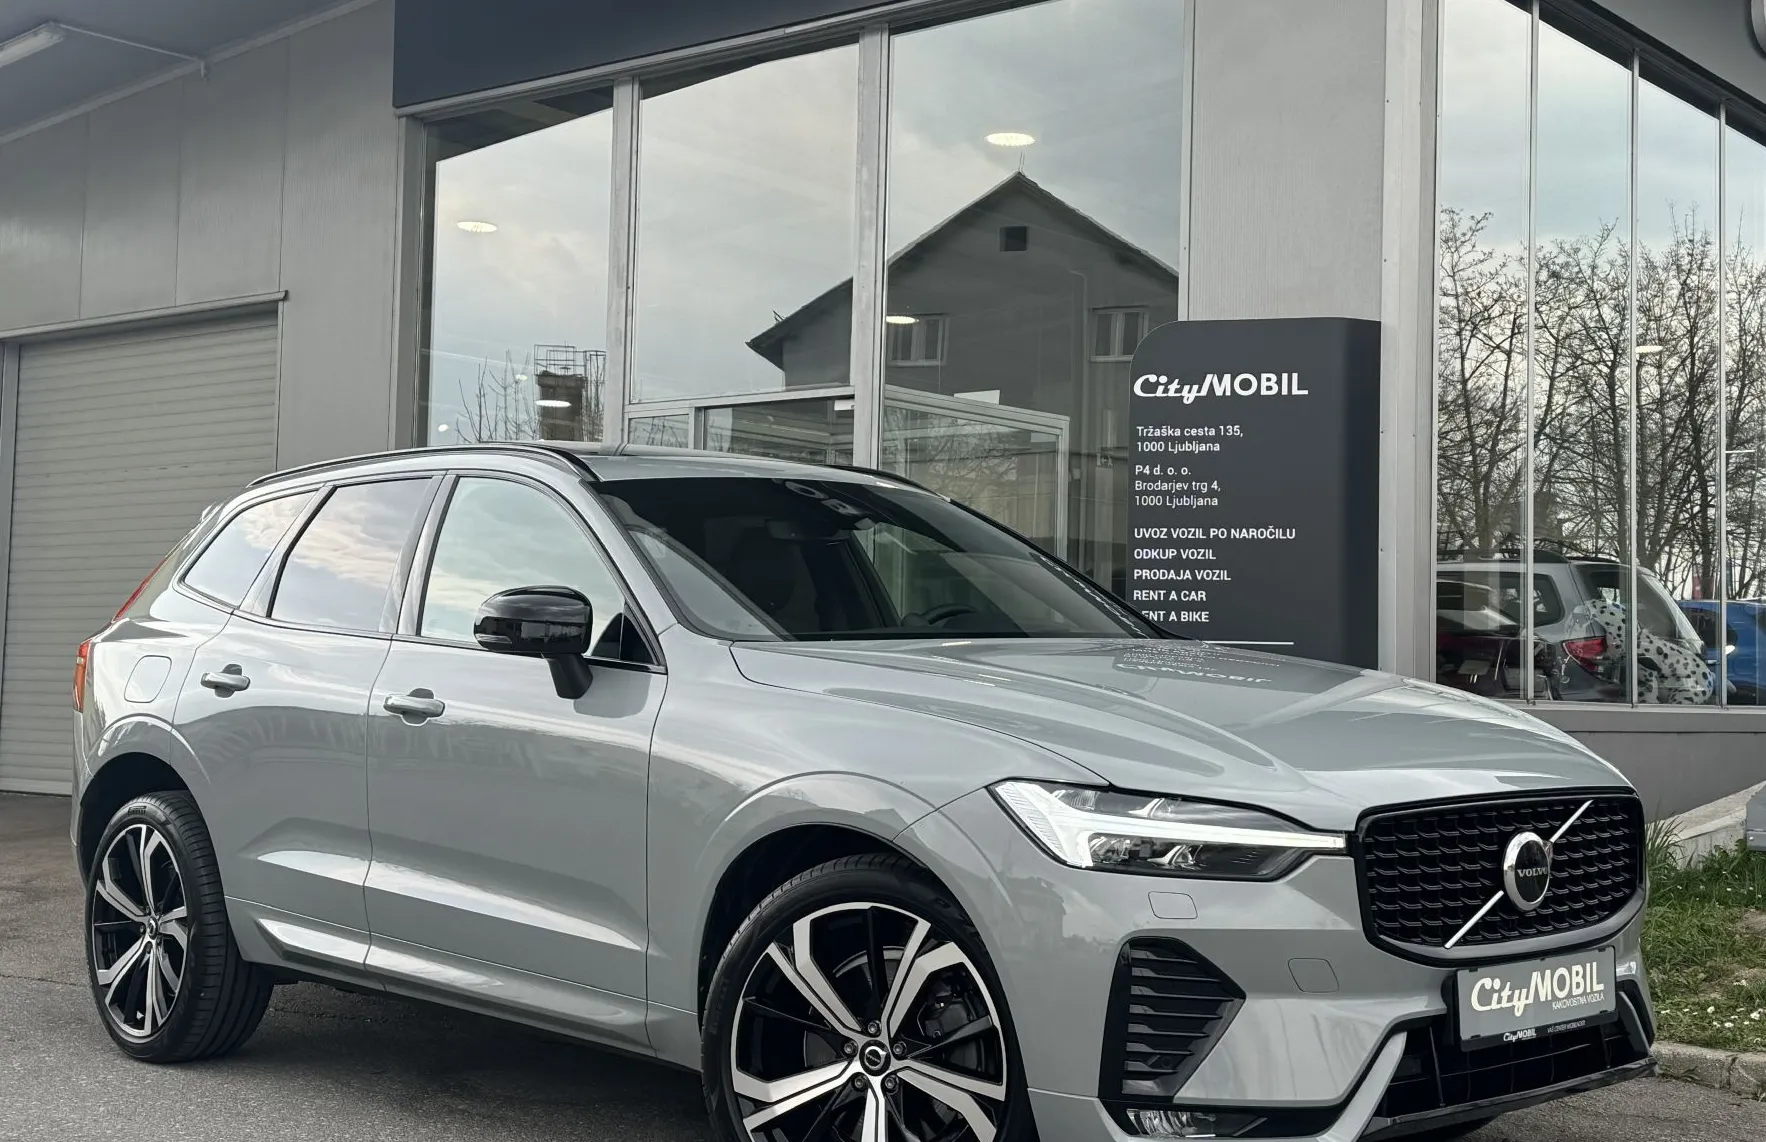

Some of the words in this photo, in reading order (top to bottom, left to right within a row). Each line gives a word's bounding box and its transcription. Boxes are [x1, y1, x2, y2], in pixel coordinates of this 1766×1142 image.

[1133, 372, 1309, 405] CityMOBIL
[1136, 425, 1181, 437] Tržaška
[1183, 426, 1216, 437] cesta
[1218, 425, 1244, 438] 135,
[1136, 441, 1165, 452] 1000
[1168, 441, 1221, 454] Ljubljana
[1135, 464, 1151, 476] P4
[1153, 463, 1164, 476] d.
[1167, 466, 1178, 476] o.
[1180, 466, 1192, 476] o.
[1134, 480, 1189, 493] Brodarjev
[1191, 480, 1208, 493] trg
[1210, 480, 1221, 492] 4,
[1134, 495, 1163, 506] 1000
[1166, 495, 1219, 508] Ljubljana
[1134, 527, 1168, 539] UVOZ
[1170, 527, 1207, 539] VOZIL
[1209, 527, 1228, 539] PO
[1230, 525, 1296, 540] NAROČILU
[1133, 548, 1178, 560] ODKUP
[1180, 548, 1217, 560] VOZIL
[1133, 569, 1193, 581] PRODAJA
[1194, 569, 1232, 581] VOZIL
[1133, 590, 1167, 601] RENT
[1168, 590, 1178, 601] A
[1180, 590, 1207, 602] CAR
[1141, 610, 1167, 622] ENT
[1168, 610, 1178, 622] A
[1180, 610, 1210, 622] BIKE
[1516, 866, 1548, 878] VOLVO
[1470, 961, 1605, 1017] CityMOBIL
